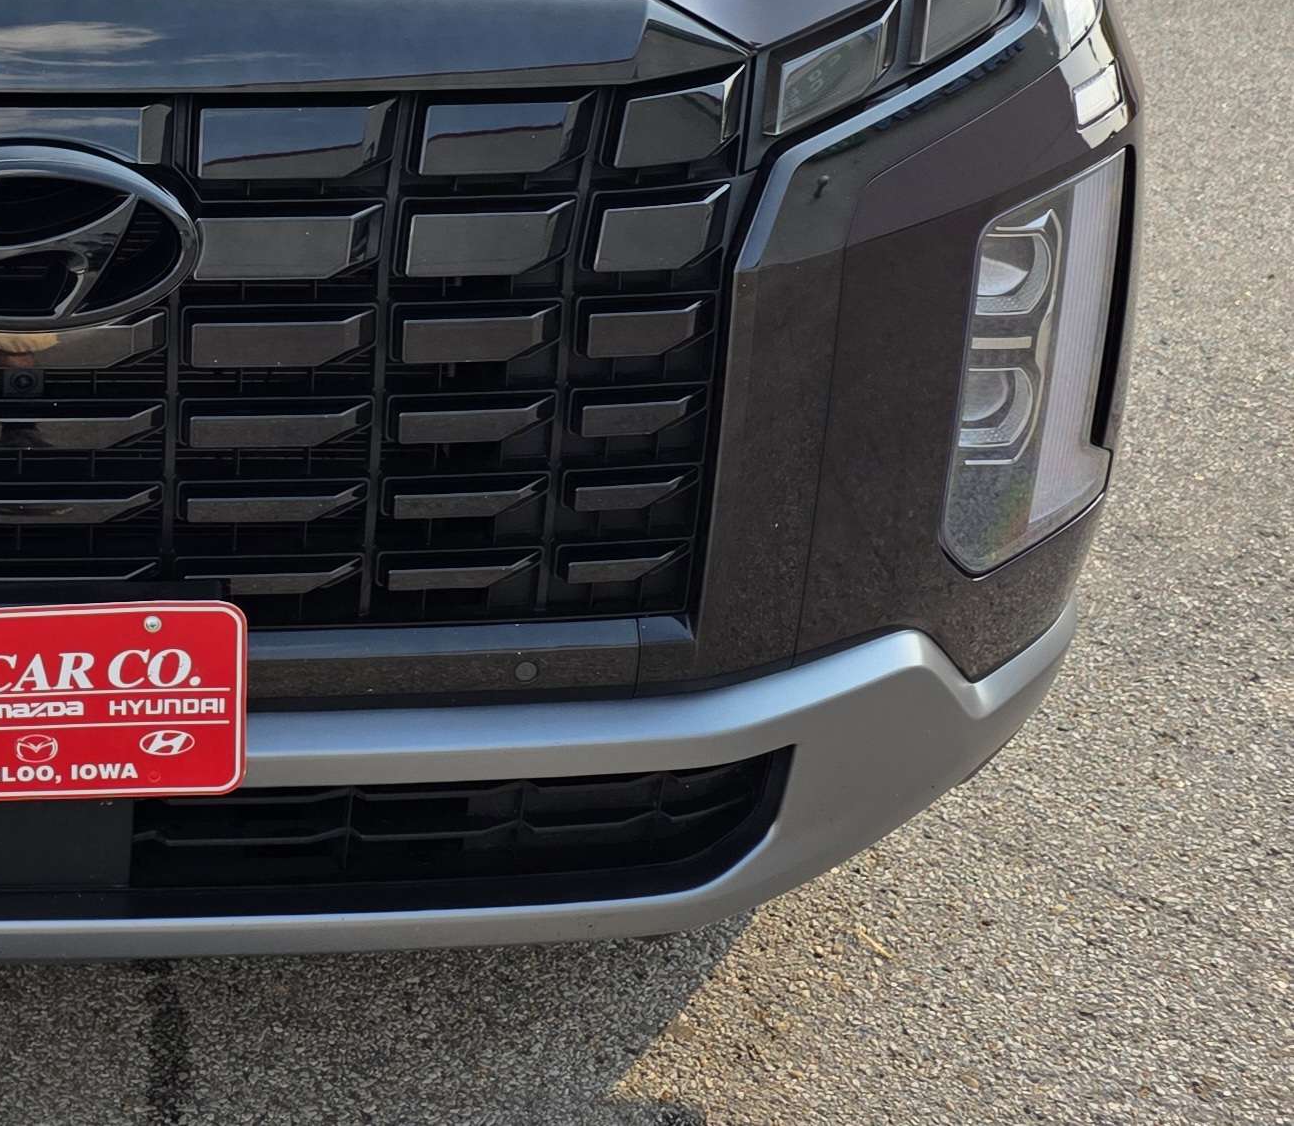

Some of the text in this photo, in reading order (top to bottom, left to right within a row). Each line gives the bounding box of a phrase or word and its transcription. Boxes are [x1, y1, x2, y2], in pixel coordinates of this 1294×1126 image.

[108, 648, 202, 688] CO.
[109, 697, 226, 716] HYUNDAI
[71, 762, 139, 780] IOWA
